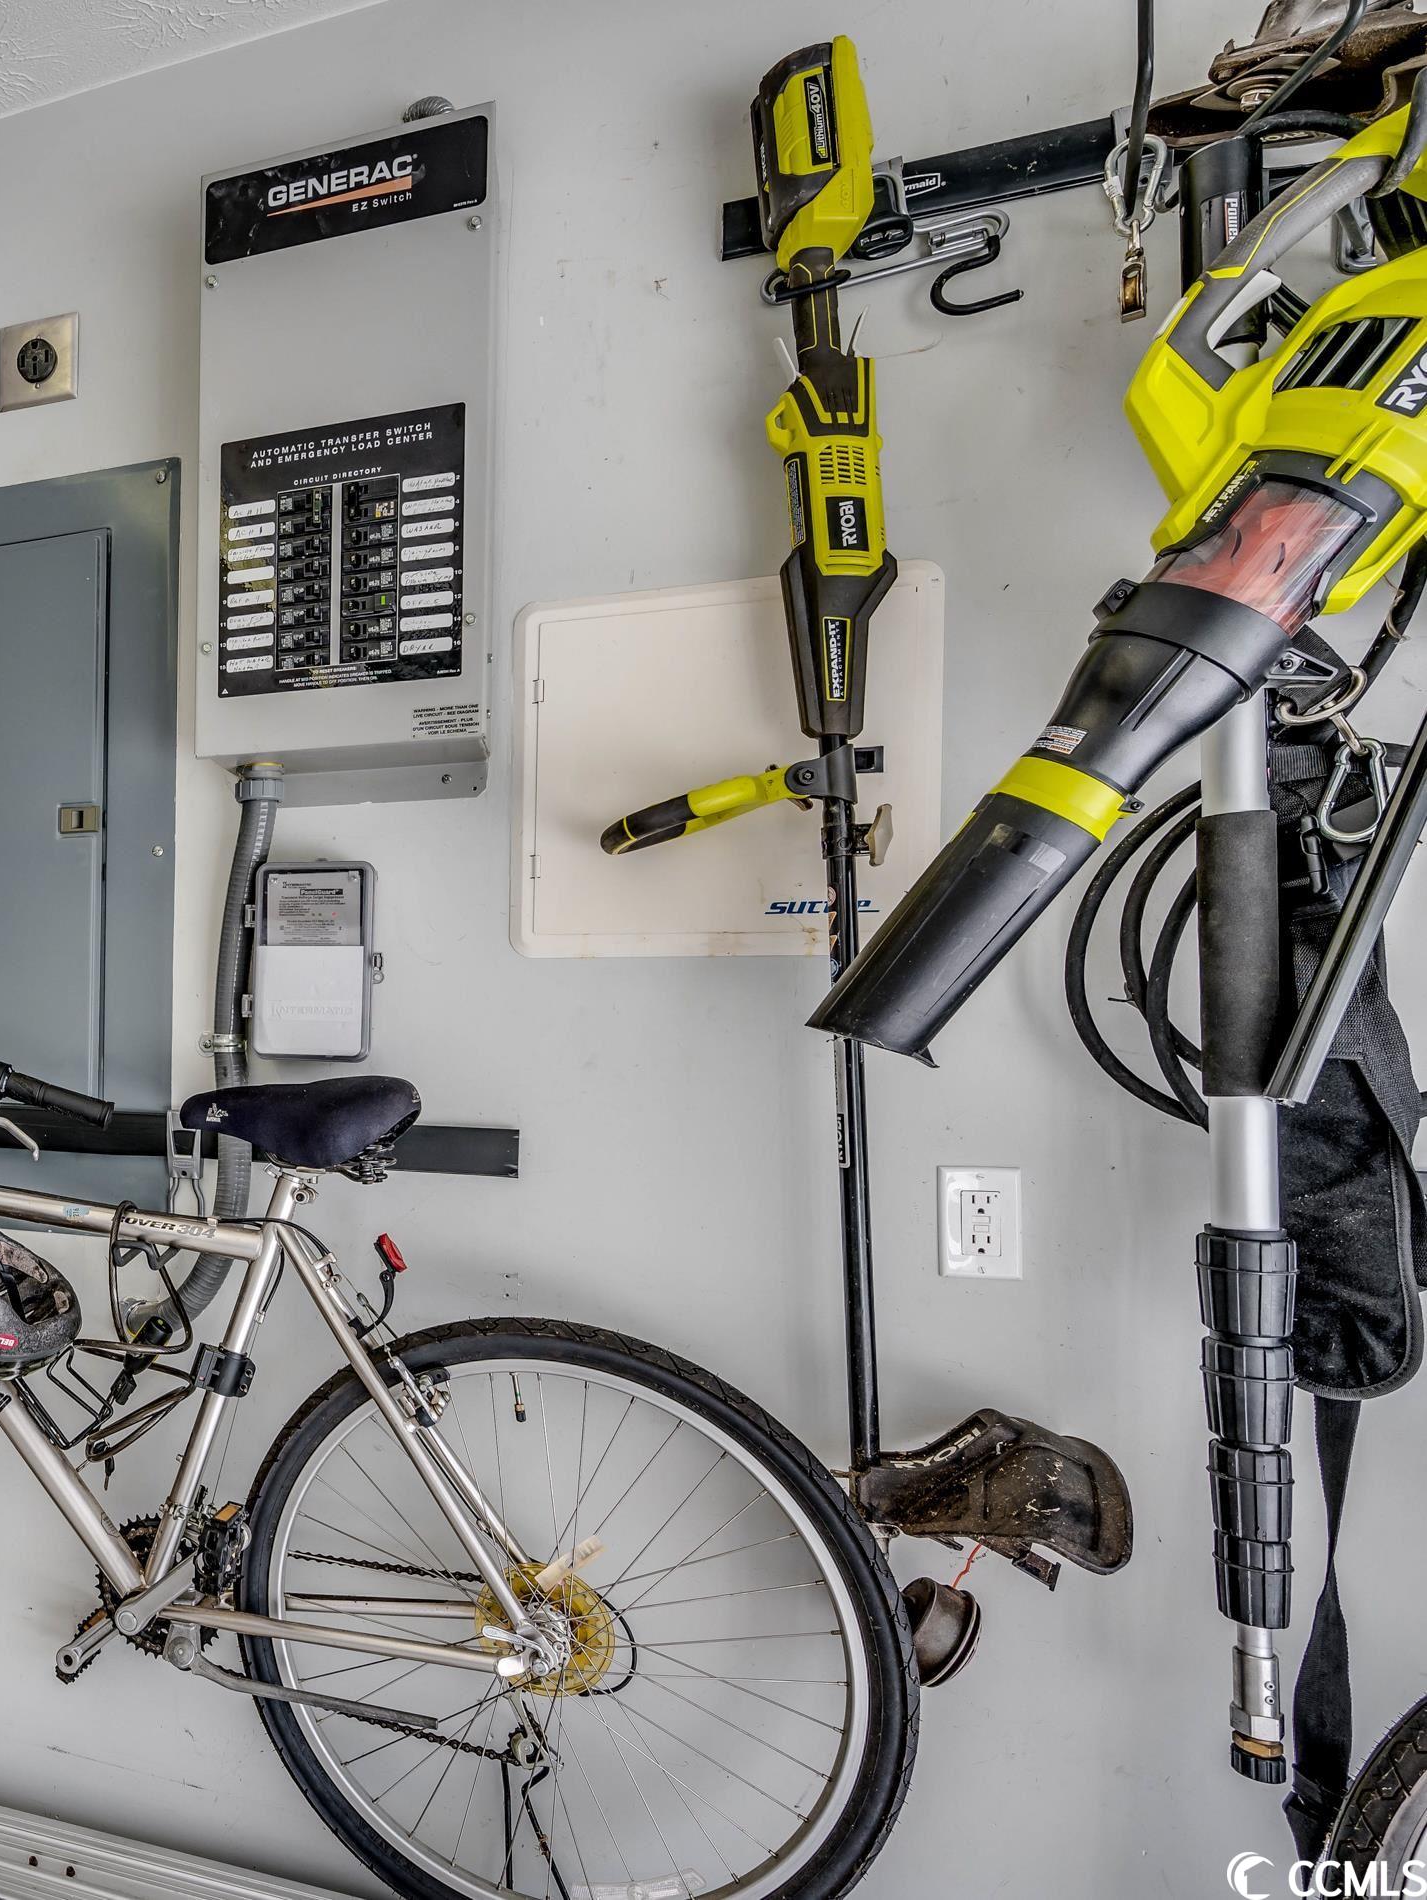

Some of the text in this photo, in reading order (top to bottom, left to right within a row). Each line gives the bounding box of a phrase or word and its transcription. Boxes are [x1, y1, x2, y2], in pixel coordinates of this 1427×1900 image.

[267, 154, 413, 208] GENERAC
[352, 191, 413, 212] EZ Switch
[250, 431, 433, 469] AND EMERGENCY LOAD CENTER
[252, 422, 431, 459] AUTOMATIC TRANSFER SWITCH
[293, 466, 382, 486] CIRCUIT DIRECTORY
[842, 500, 858, 547] RYOBI
[176, 1224, 217, 1239] 304
[889, 1427, 981, 1469] RYOBI
